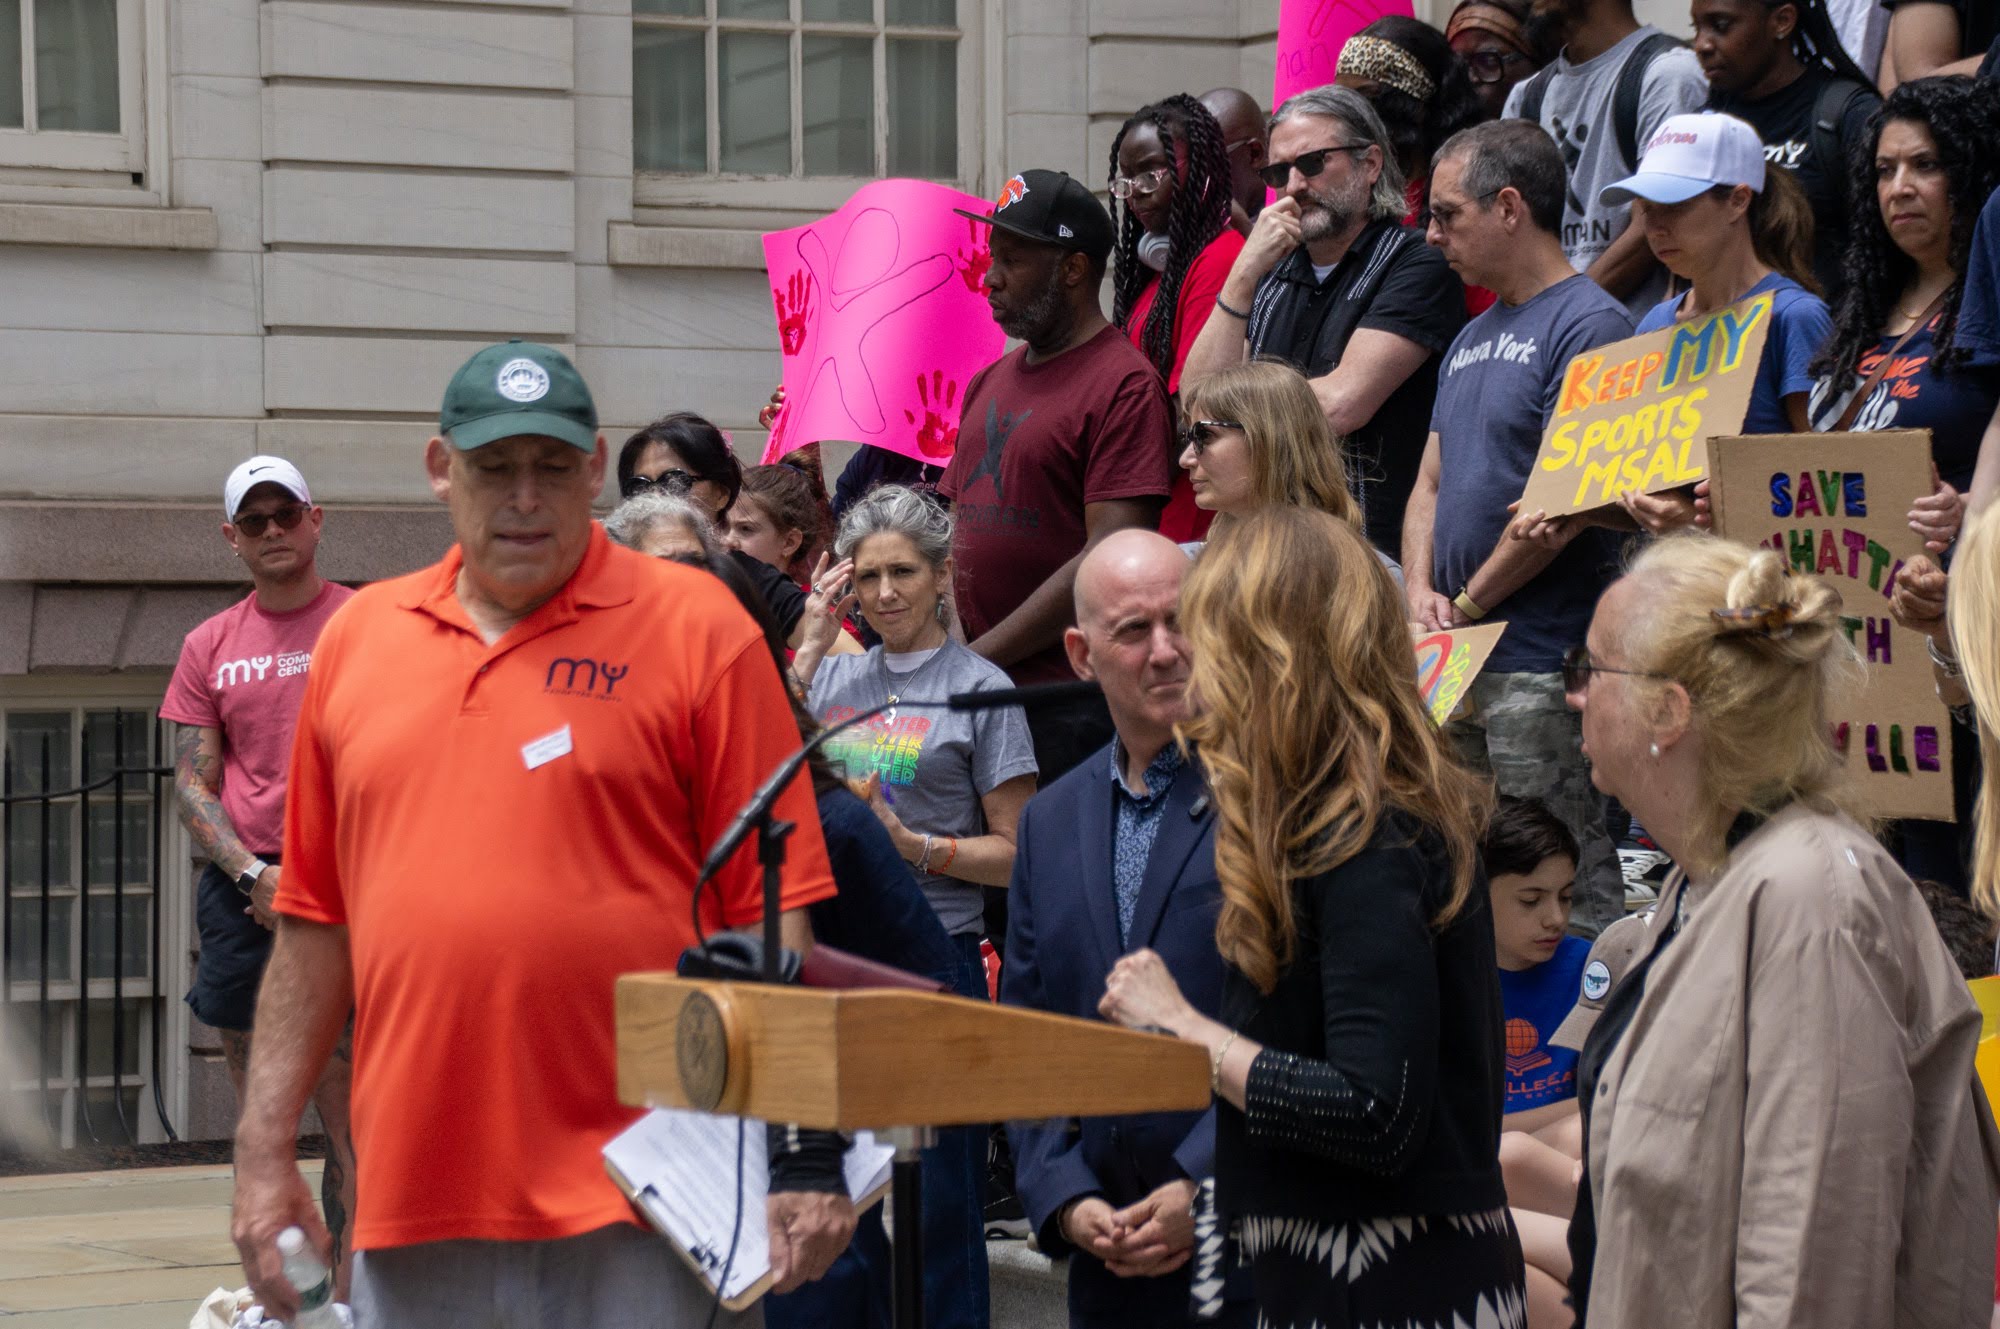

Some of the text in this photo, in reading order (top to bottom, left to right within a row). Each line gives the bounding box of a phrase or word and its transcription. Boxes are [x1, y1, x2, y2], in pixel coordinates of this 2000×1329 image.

[1493, 332, 1537, 365] York
[1557, 296, 1774, 418] KEEP MY
[1541, 387, 1709, 472] SPORTS
[1572, 439, 1703, 508] MSAL
[1769, 470, 1867, 519] SAVE
[1838, 616, 1892, 665] TH
[277, 663, 311, 678] CENT
